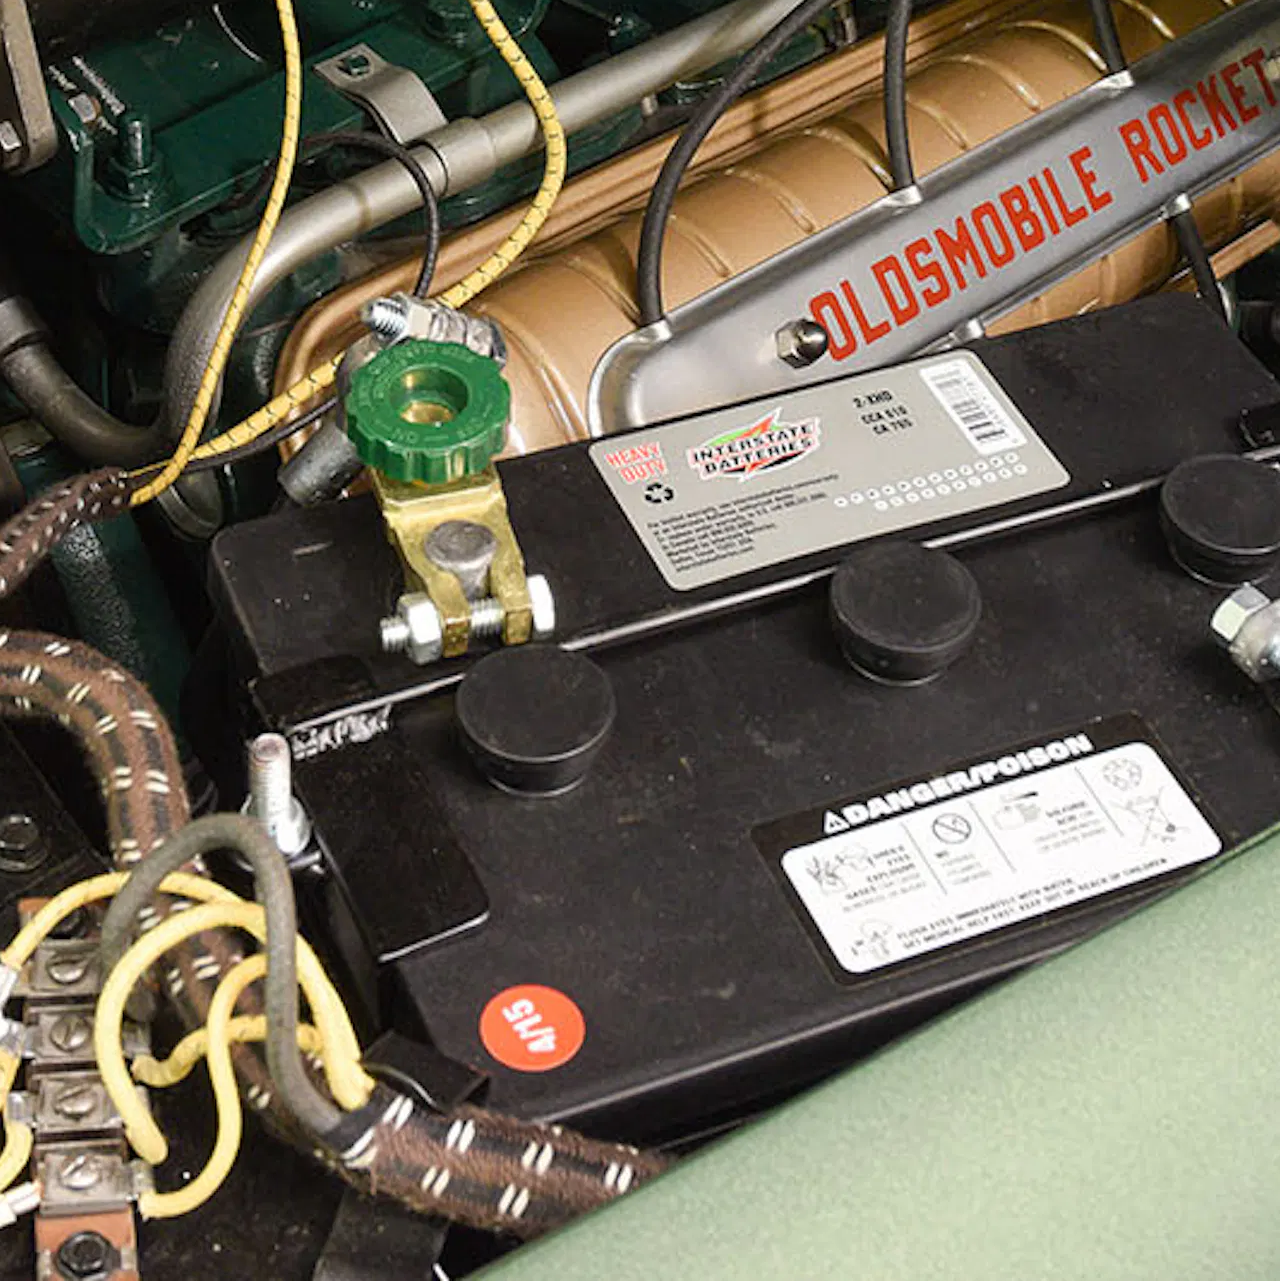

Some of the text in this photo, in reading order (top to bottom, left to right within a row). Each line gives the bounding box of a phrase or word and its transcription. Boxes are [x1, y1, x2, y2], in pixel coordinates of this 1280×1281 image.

[808, 48, 1280, 361] OLDSMOBILE ROCKET
[605, 442, 660, 467] HEAVY
[692, 423, 813, 462] INTERSTATE
[704, 438, 813, 474] BATTERIES
[620, 457, 667, 484] DUTY
[841, 733, 1094, 826] DANGER/POISON
[501, 998, 557, 1053] 4/15
